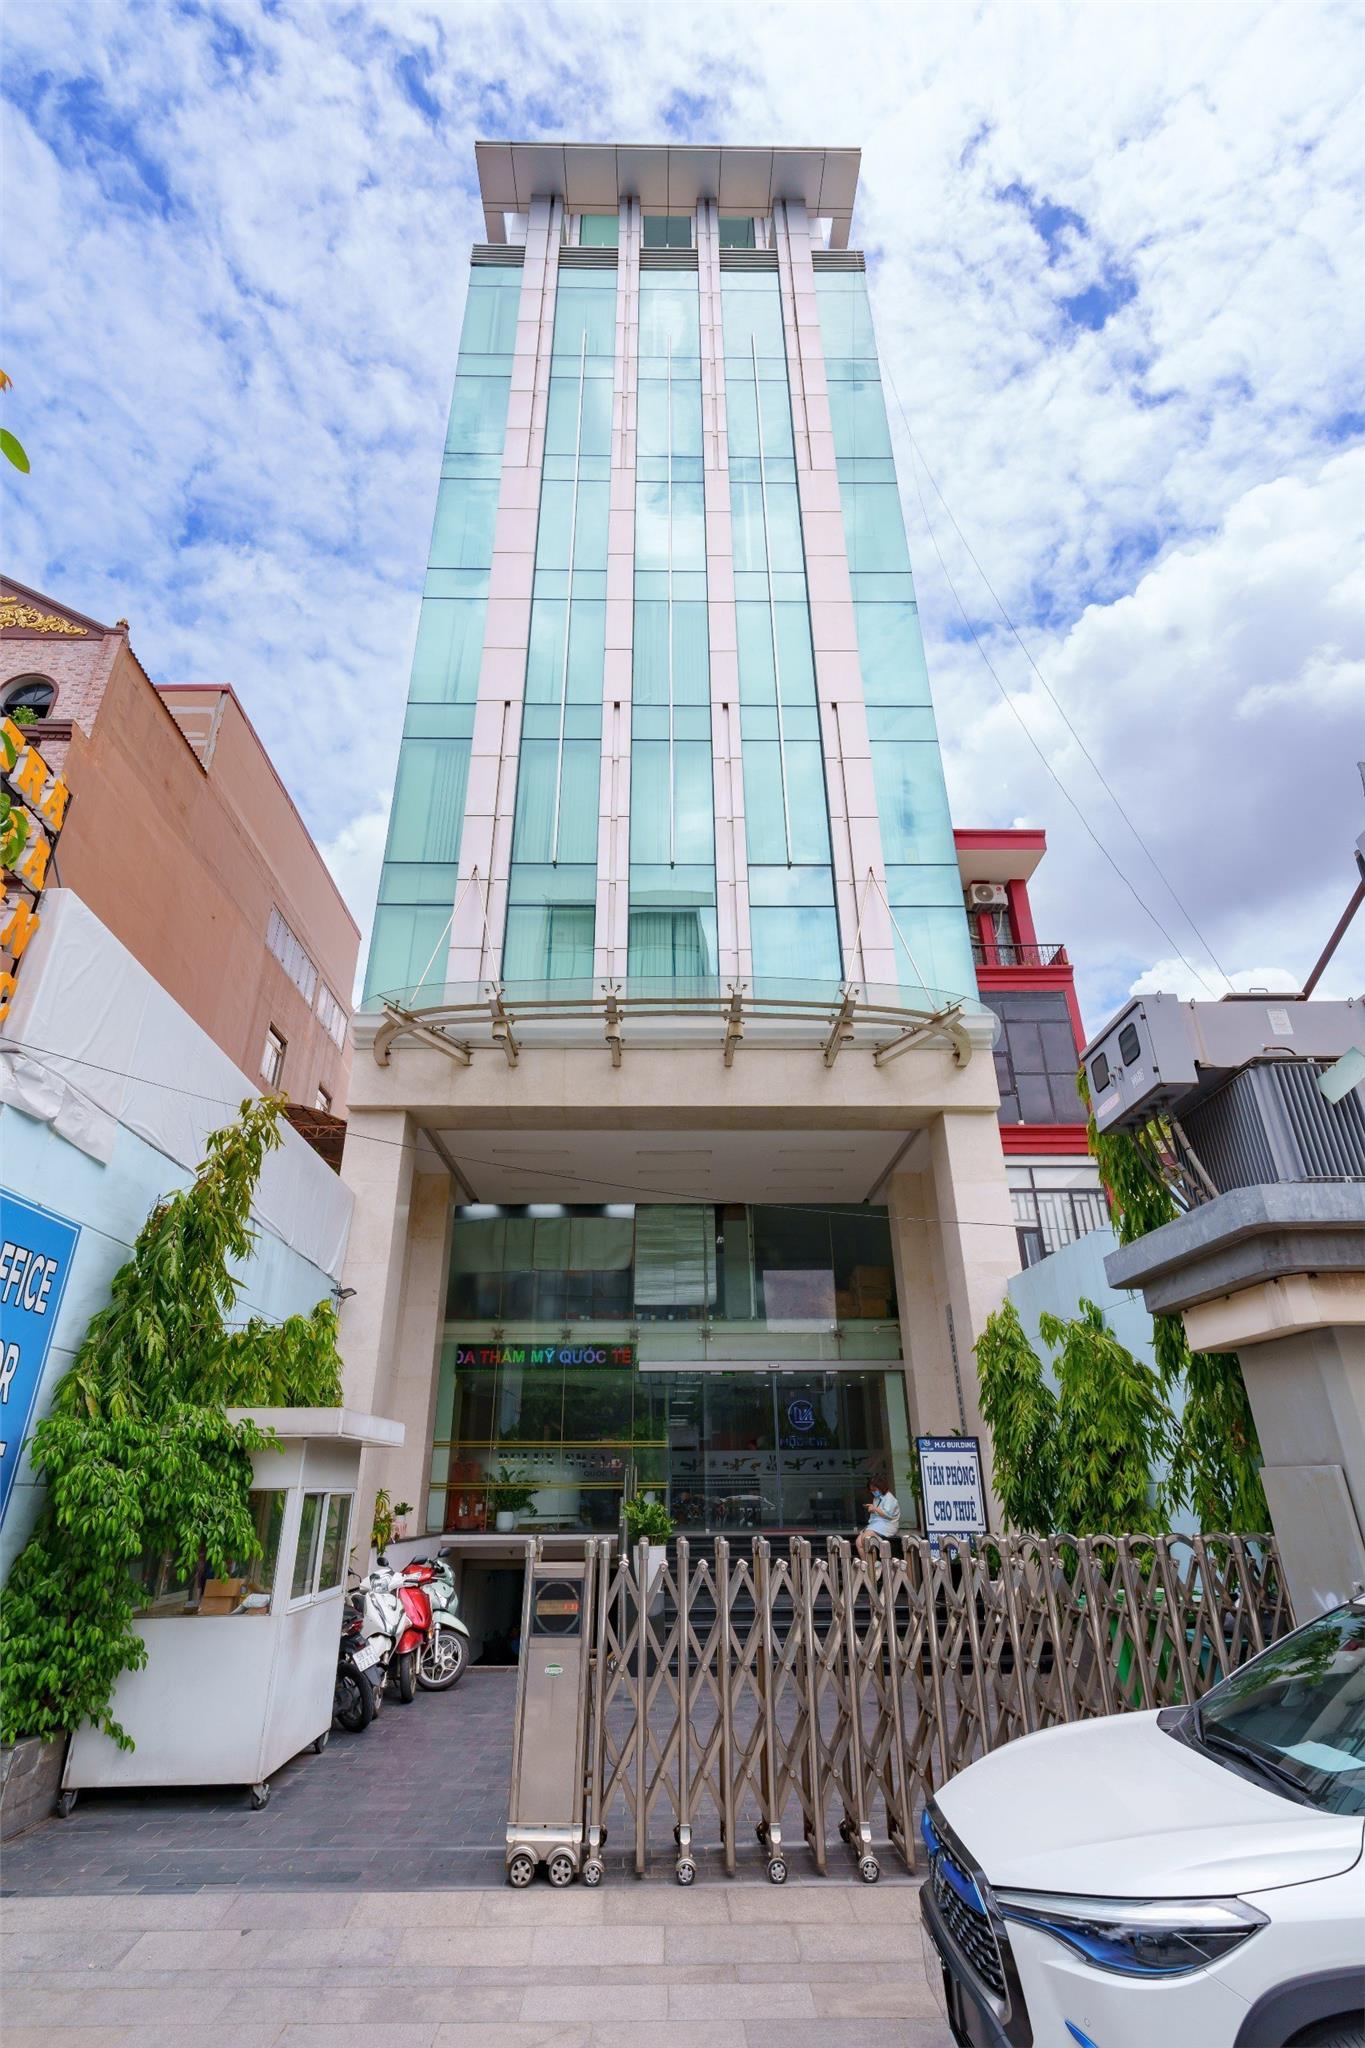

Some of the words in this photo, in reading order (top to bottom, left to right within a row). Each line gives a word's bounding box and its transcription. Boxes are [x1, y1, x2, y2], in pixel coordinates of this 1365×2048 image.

[0, 1338, 20, 1404] R
[947, 1441, 976, 1449] BUILDING
[933, 1500, 952, 1522] CHO
